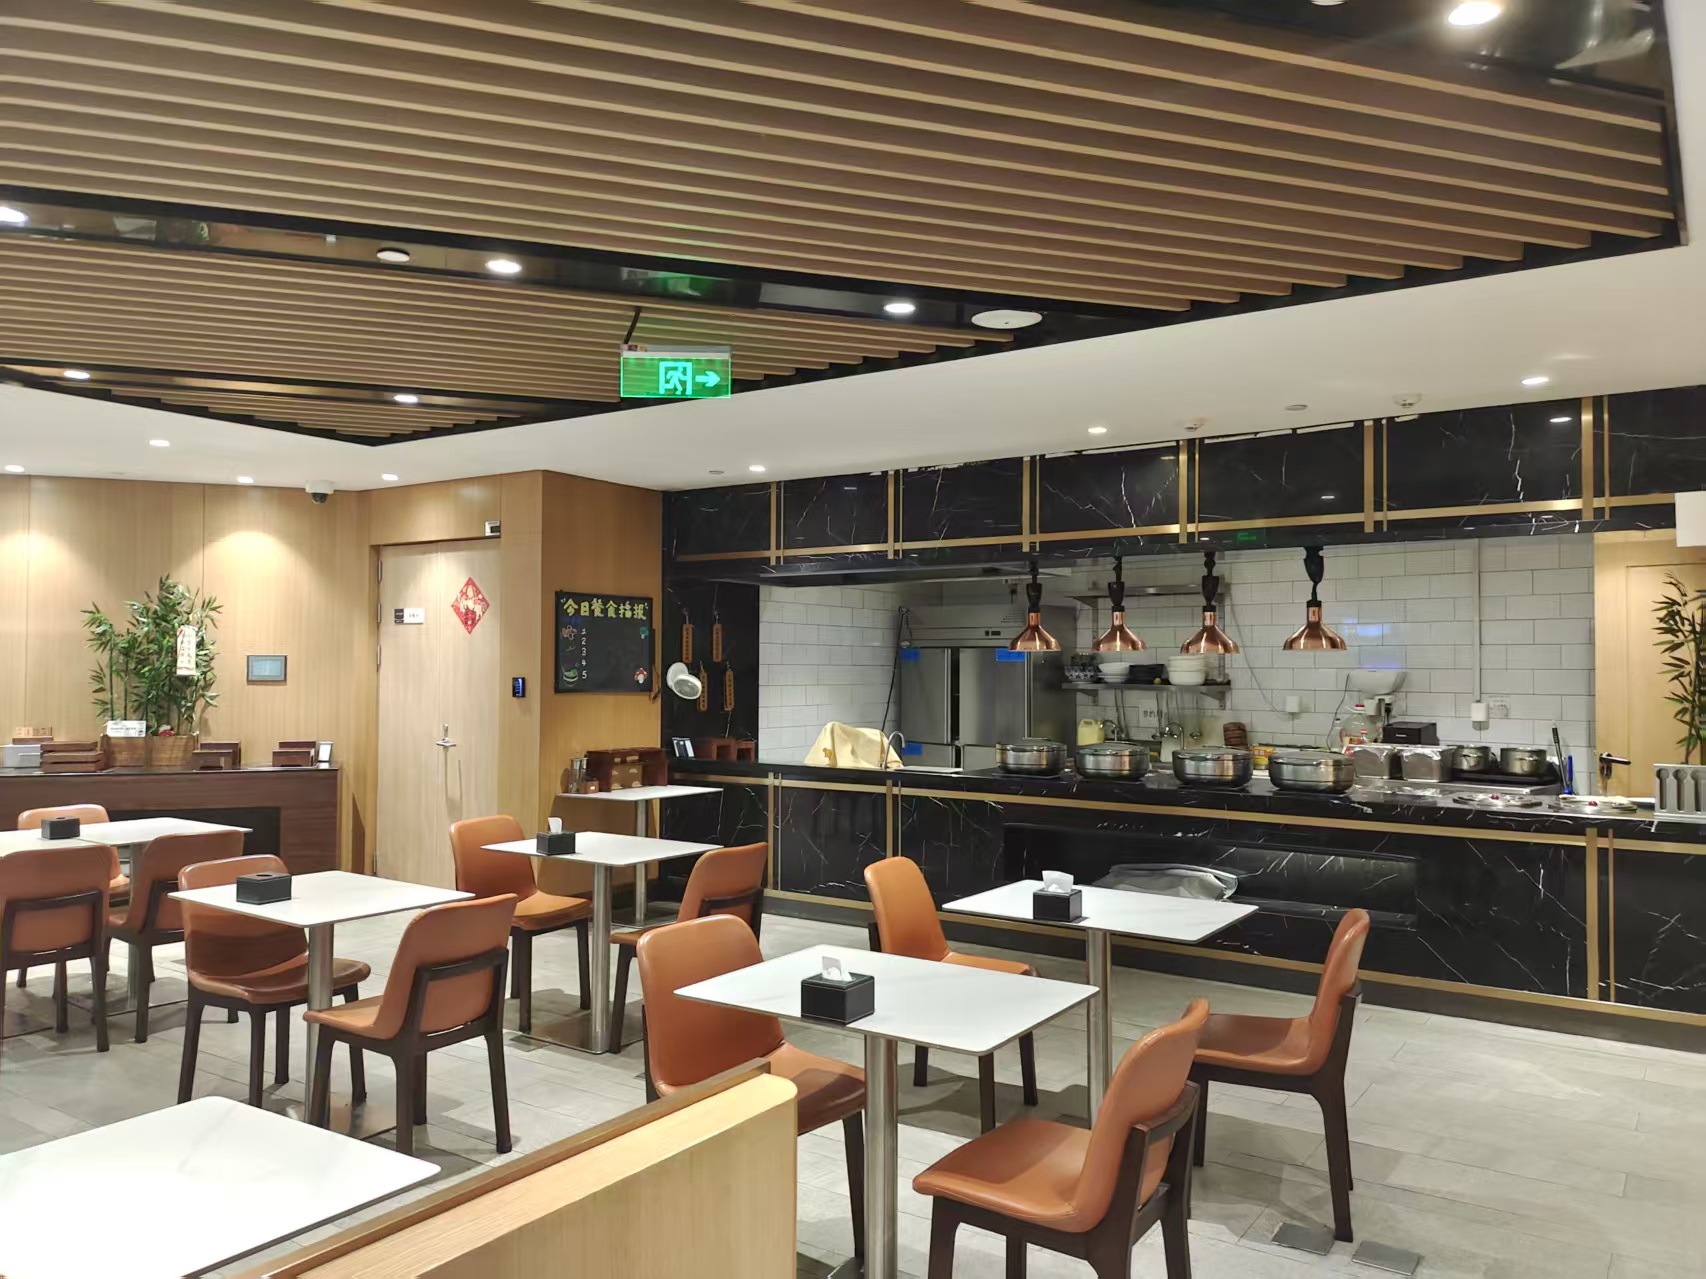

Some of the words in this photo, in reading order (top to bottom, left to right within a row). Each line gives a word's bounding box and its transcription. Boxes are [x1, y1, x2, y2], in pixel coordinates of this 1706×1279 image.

[581, 637, 587, 645] 2
[581, 647, 587, 656] 3
[581, 659, 587, 667] 4
[581, 670, 588, 679] 5
